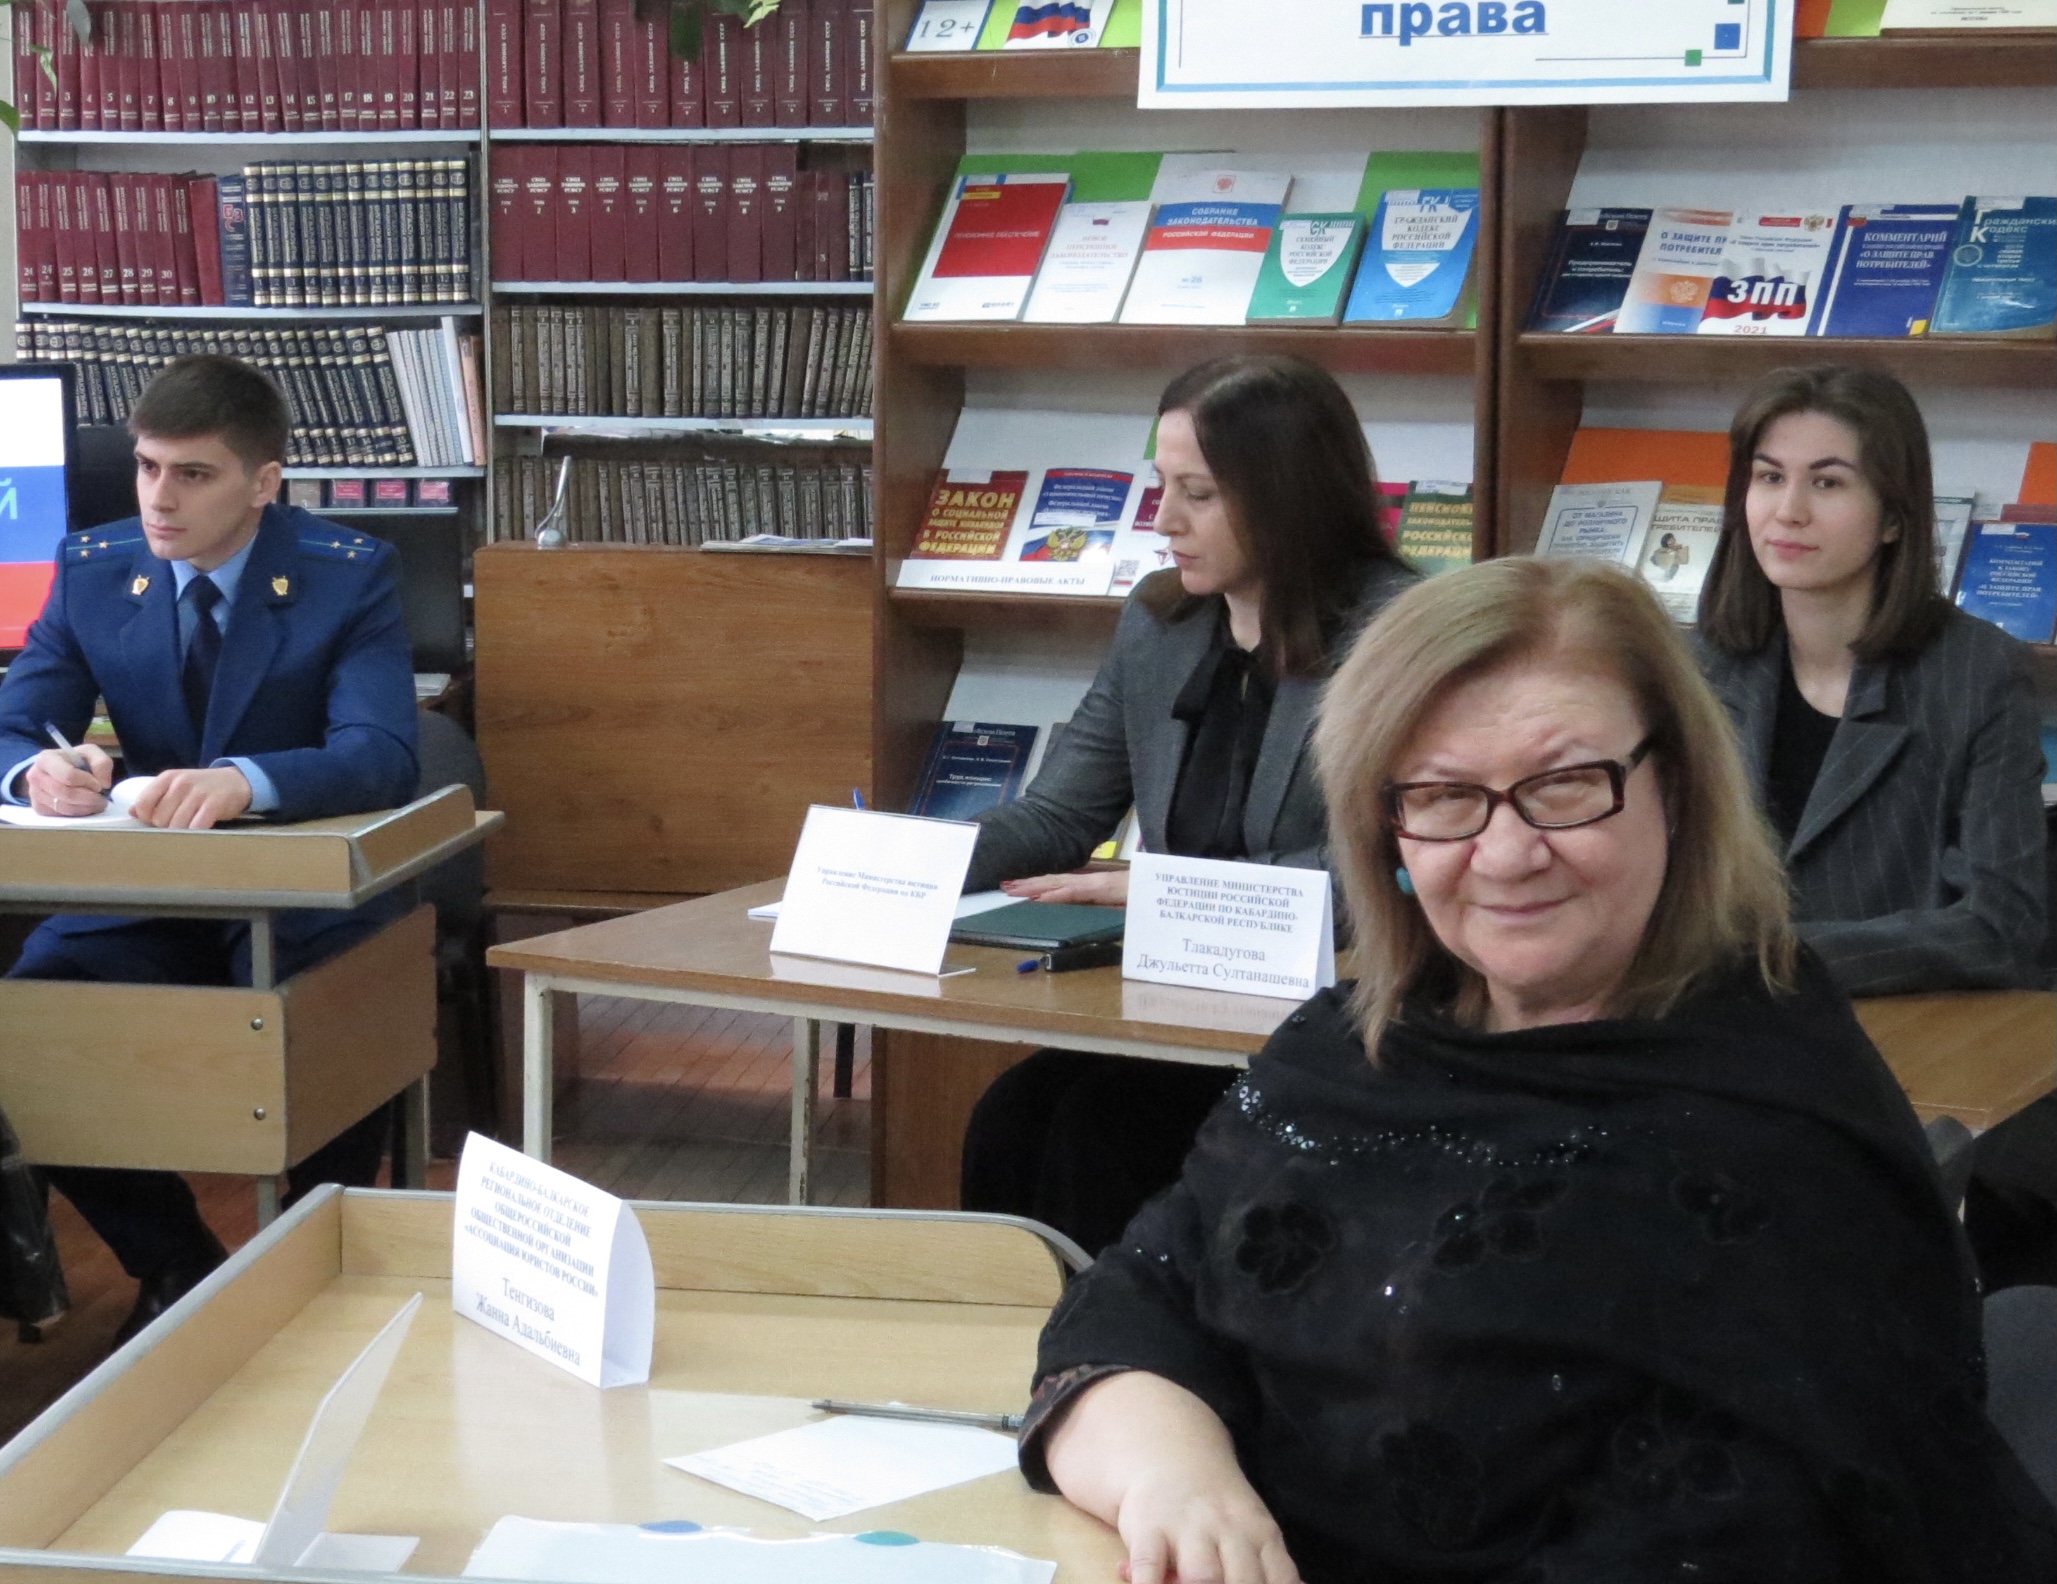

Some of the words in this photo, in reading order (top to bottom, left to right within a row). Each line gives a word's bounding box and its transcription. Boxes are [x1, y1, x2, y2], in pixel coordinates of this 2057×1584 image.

[919, 19, 975, 38] 12+
[1361, 1, 1546, 46] права
[1166, 217, 1258, 226] ЗАКОНОДАТЕЛЬСТВА
[1191, 208, 1239, 216] СОБРАНИЕ
[1394, 214, 1458, 224] ГРАЖДАНСКИЙ
[1392, 232, 1451, 240] РОССИЙСКОЙ
[1661, 231, 1668, 239] О
[1671, 232, 1711, 243] ЗАЩИТЕ
[1864, 231, 1947, 242] КОММЕНТАРИЙ
[1727, 280, 1798, 306] ЗПП
[1733, 325, 1768, 334] 2021
[935, 490, 1015, 508] ЗАКОН
[932, 508, 940, 517] О
[943, 508, 1009, 519] СОЦИАЛЬНОЙ
[923, 529, 931, 538] В
[935, 530, 1001, 541] РОССИЙСКОЙ
[918, 541, 996, 555] ФЕДЕРАЦИИ
[930, 574, 1053, 585] НОРМАТИВНО-ПРАВОВЫЕ
[1057, 577, 1085, 586] АКТЫ
[1155, 873, 1220, 888] УПРАВЛЕНИЕ
[1222, 880, 1304, 898] МИНИСТЕРСТВА
[1167, 886, 1218, 900] ЮСТИЦИИ
[1220, 892, 1290, 908] РОССИЙСКОЙ
[1156, 898, 1216, 912] ФЕДЕРАЦИИ
[1218, 904, 1233, 913] ПО
[1234, 906, 1298, 921] КАБАРДИНО-
[1159, 909, 1225, 925] БАЛКАРСКОЙ
[1227, 917, 1293, 933] РЕСПУБЛИКЕ
[1182, 938, 1266, 962] Тлакадугова
[1137, 953, 1209, 976] Джульетта
[1212, 963, 1310, 989] Султанашевна
[489, 1161, 591, 1218] КАБАРДИНО-БАЛКАРСКОЕ
[481, 1175, 541, 1215] РЕГИОНАЛЬНОЕ
[543, 1205, 592, 1238] ОТДЕЛЕНИЕ
[494, 1201, 572, 1248] ОБЩЕРОССИЙСКОЙ
[471, 1207, 534, 1247] ОБЩЕСТВЕННОЙ
[535, 1237, 595, 1276] ОРГАНИЗАЦИИ
[521, 1249, 561, 1279] ЮРИСТОВ
[502, 1276, 555, 1322] Тенгизова
[476, 1292, 510, 1328] Жанна
[511, 1314, 581, 1367] Адальбиевна
